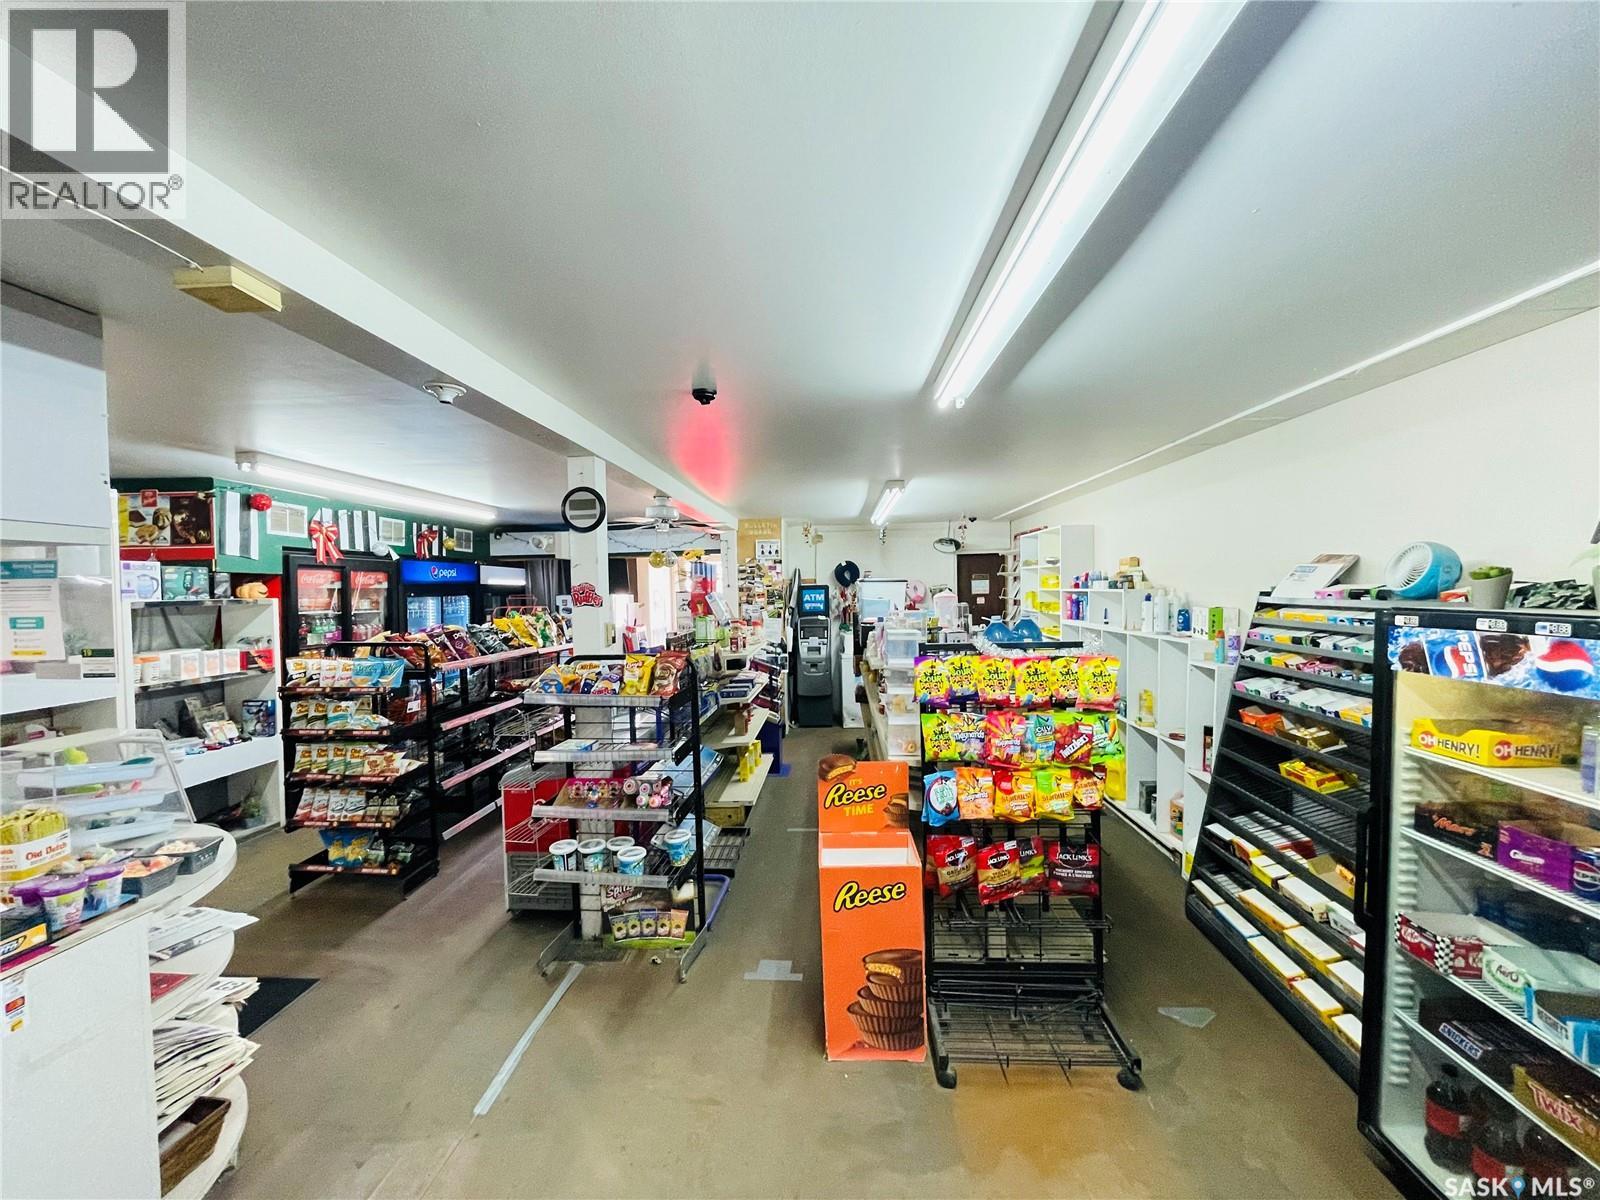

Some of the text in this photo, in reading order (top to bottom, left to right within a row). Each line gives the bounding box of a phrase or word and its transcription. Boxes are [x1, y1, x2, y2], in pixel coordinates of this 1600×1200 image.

[438, 567, 457, 578] pepsi
[803, 593, 825, 601] ATM
[1455, 632, 1479, 678] PEPSI
[1418, 735, 1480, 759] OH HENRY!
[1493, 743, 1561, 759] OH HENRY!
[823, 782, 888, 810] Reese
[843, 803, 875, 817] TIME
[25, 850, 43, 861] Old
[45, 842, 68, 855] Dutch
[833, 880, 907, 913] Reese
[1440, 1024, 1480, 1058] SNICKERS
